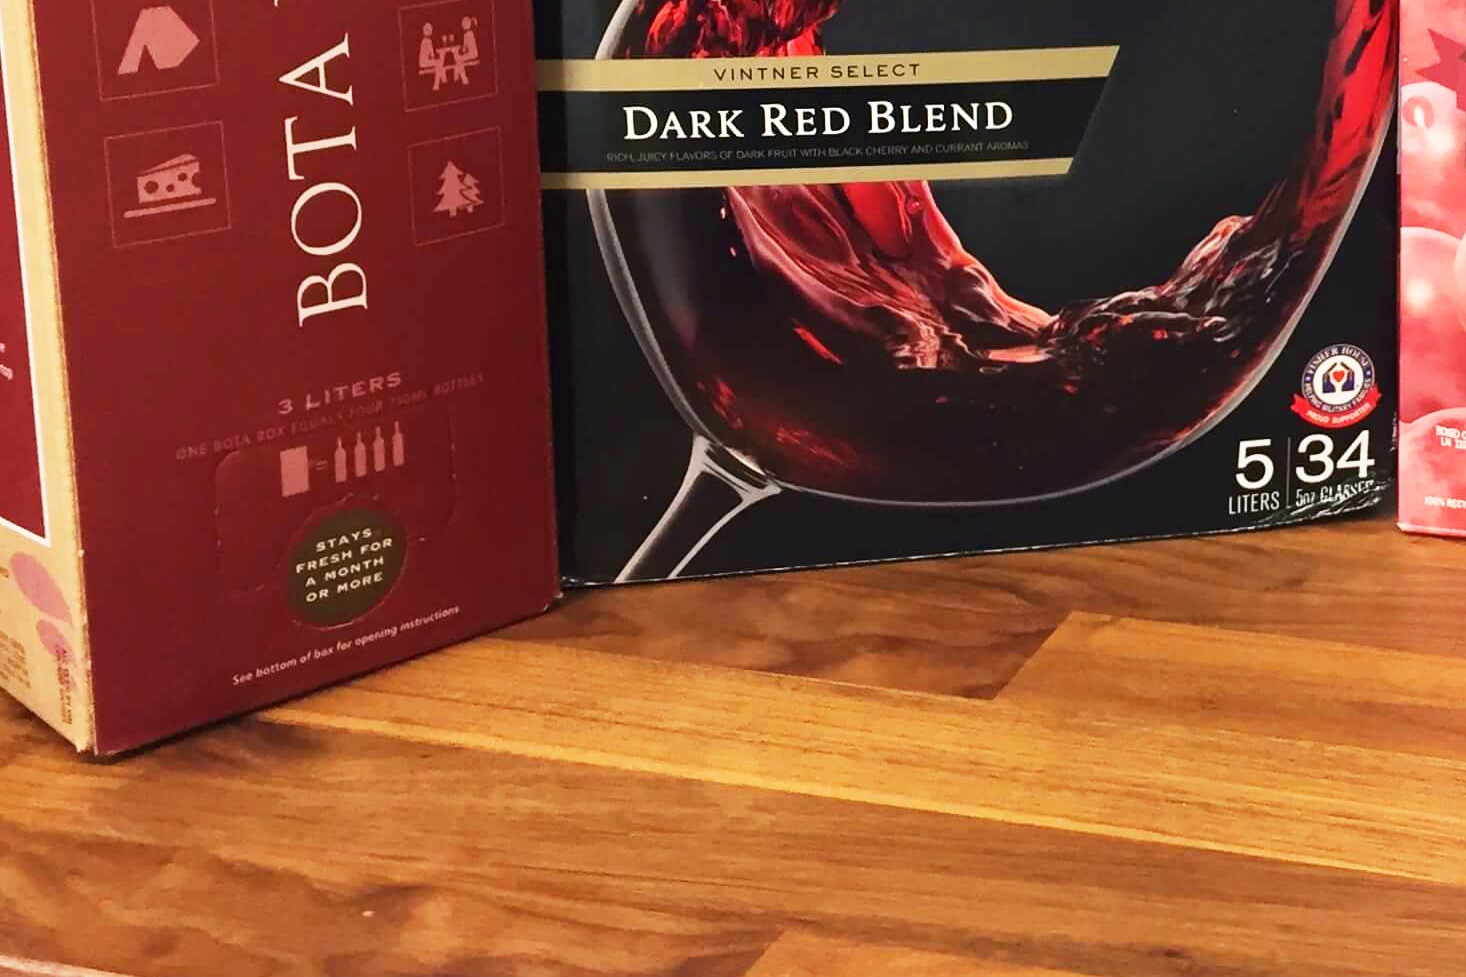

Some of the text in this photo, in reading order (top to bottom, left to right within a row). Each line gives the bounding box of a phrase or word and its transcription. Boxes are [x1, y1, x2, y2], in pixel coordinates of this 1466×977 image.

[714, 63, 920, 82] VINTNER SELECT
[623, 100, 1013, 140] DARK RED BLEND
[736, 150, 766, 160] DARK
[768, 148, 798, 159] FRUIT
[828, 147, 864, 158] BLACK
[865, 145, 909, 157] CHERRY
[910, 144, 934, 155] AND
[935, 142, 985, 154] CURRANT
[278, 32, 368, 326] BOTA
[278, 372, 403, 415] 3 LITERS
[1235, 438, 1274, 489] 5
[1296, 430, 1375, 483] 34
[1228, 491, 1280, 515] LITERS
[296, 538, 393, 573] FRESH FOR
[316, 528, 372, 552] STAYS
[305, 556, 384, 587] A MONTH
[306, 572, 383, 602] OR MORE
[232, 605, 460, 686] See bottom of box for opening instructions
